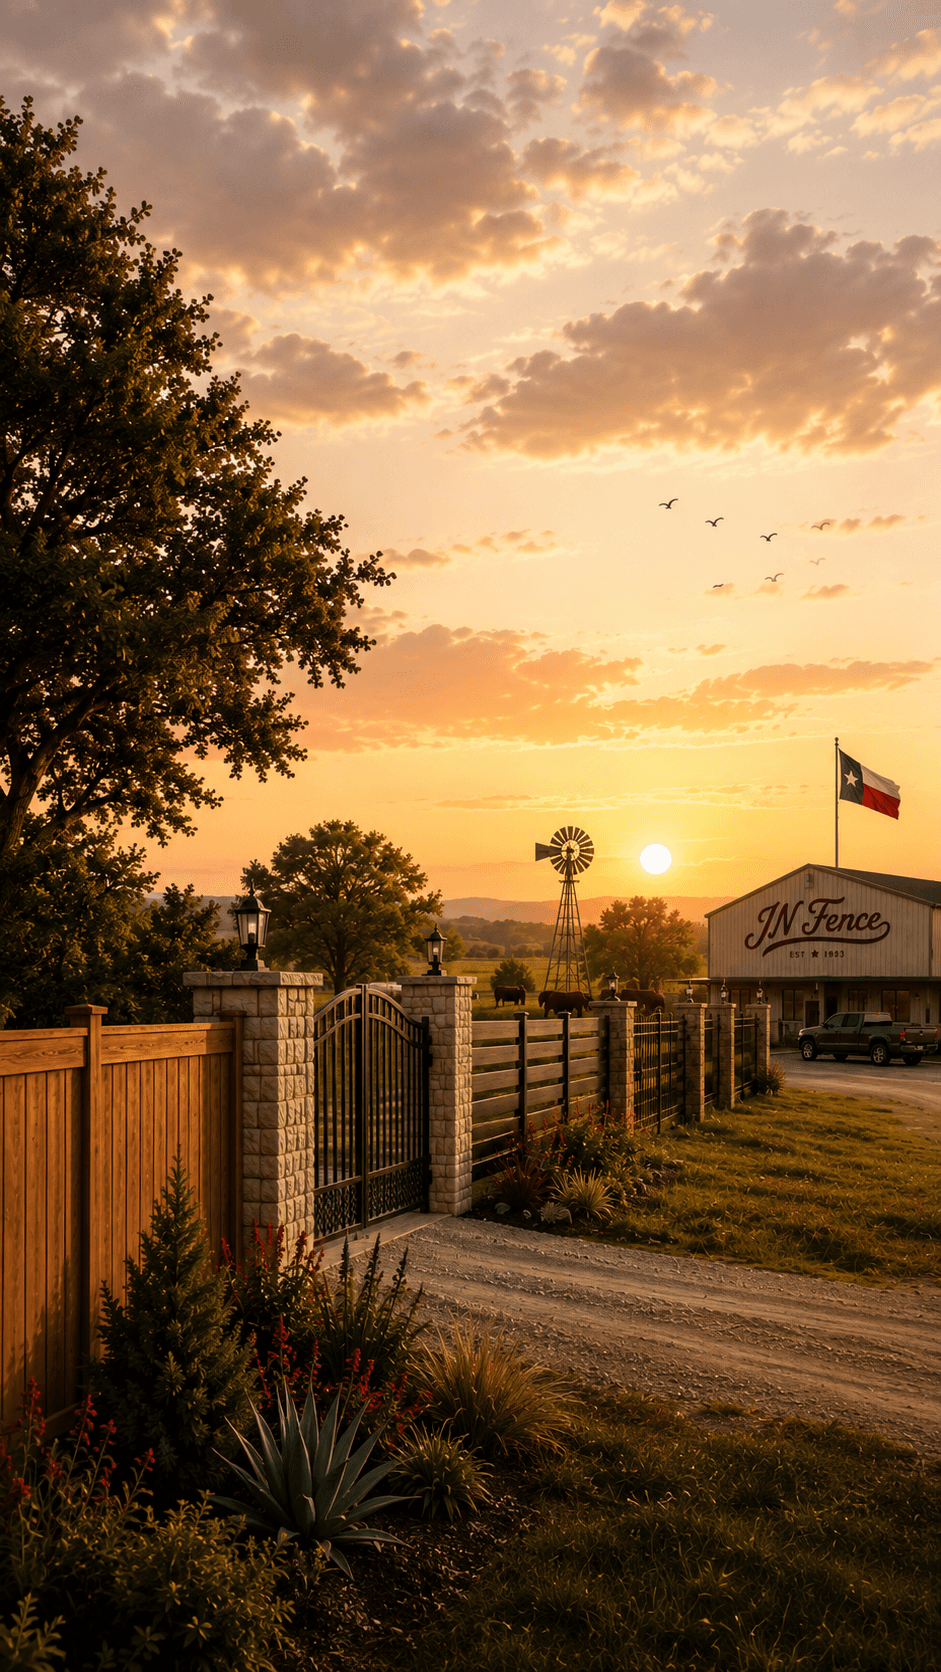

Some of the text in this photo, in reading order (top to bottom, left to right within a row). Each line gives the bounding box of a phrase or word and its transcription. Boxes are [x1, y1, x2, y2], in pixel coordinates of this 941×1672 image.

[744, 896, 890, 950] JN Fence
[789, 950, 805, 958] EST
